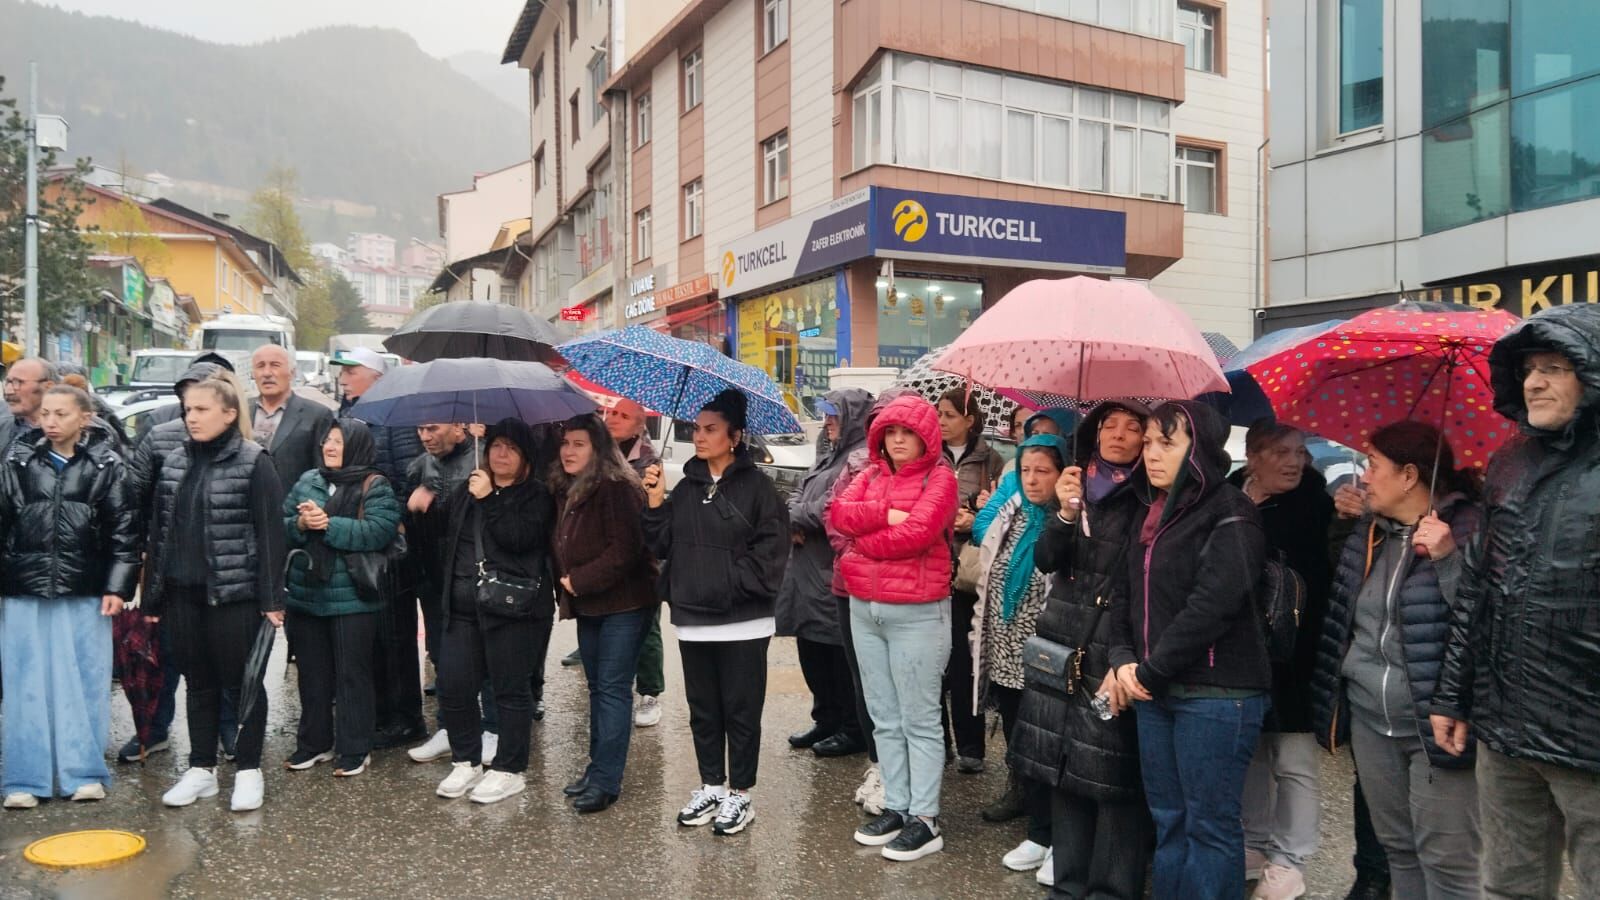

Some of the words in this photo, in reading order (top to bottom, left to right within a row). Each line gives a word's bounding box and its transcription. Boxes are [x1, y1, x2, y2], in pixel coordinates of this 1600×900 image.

[811, 235, 829, 252] ZAFER
[830, 221, 866, 247] ELEKTRONİK
[936, 212, 1042, 243] TURKCELL
[738, 240, 788, 275] TURKCELL
